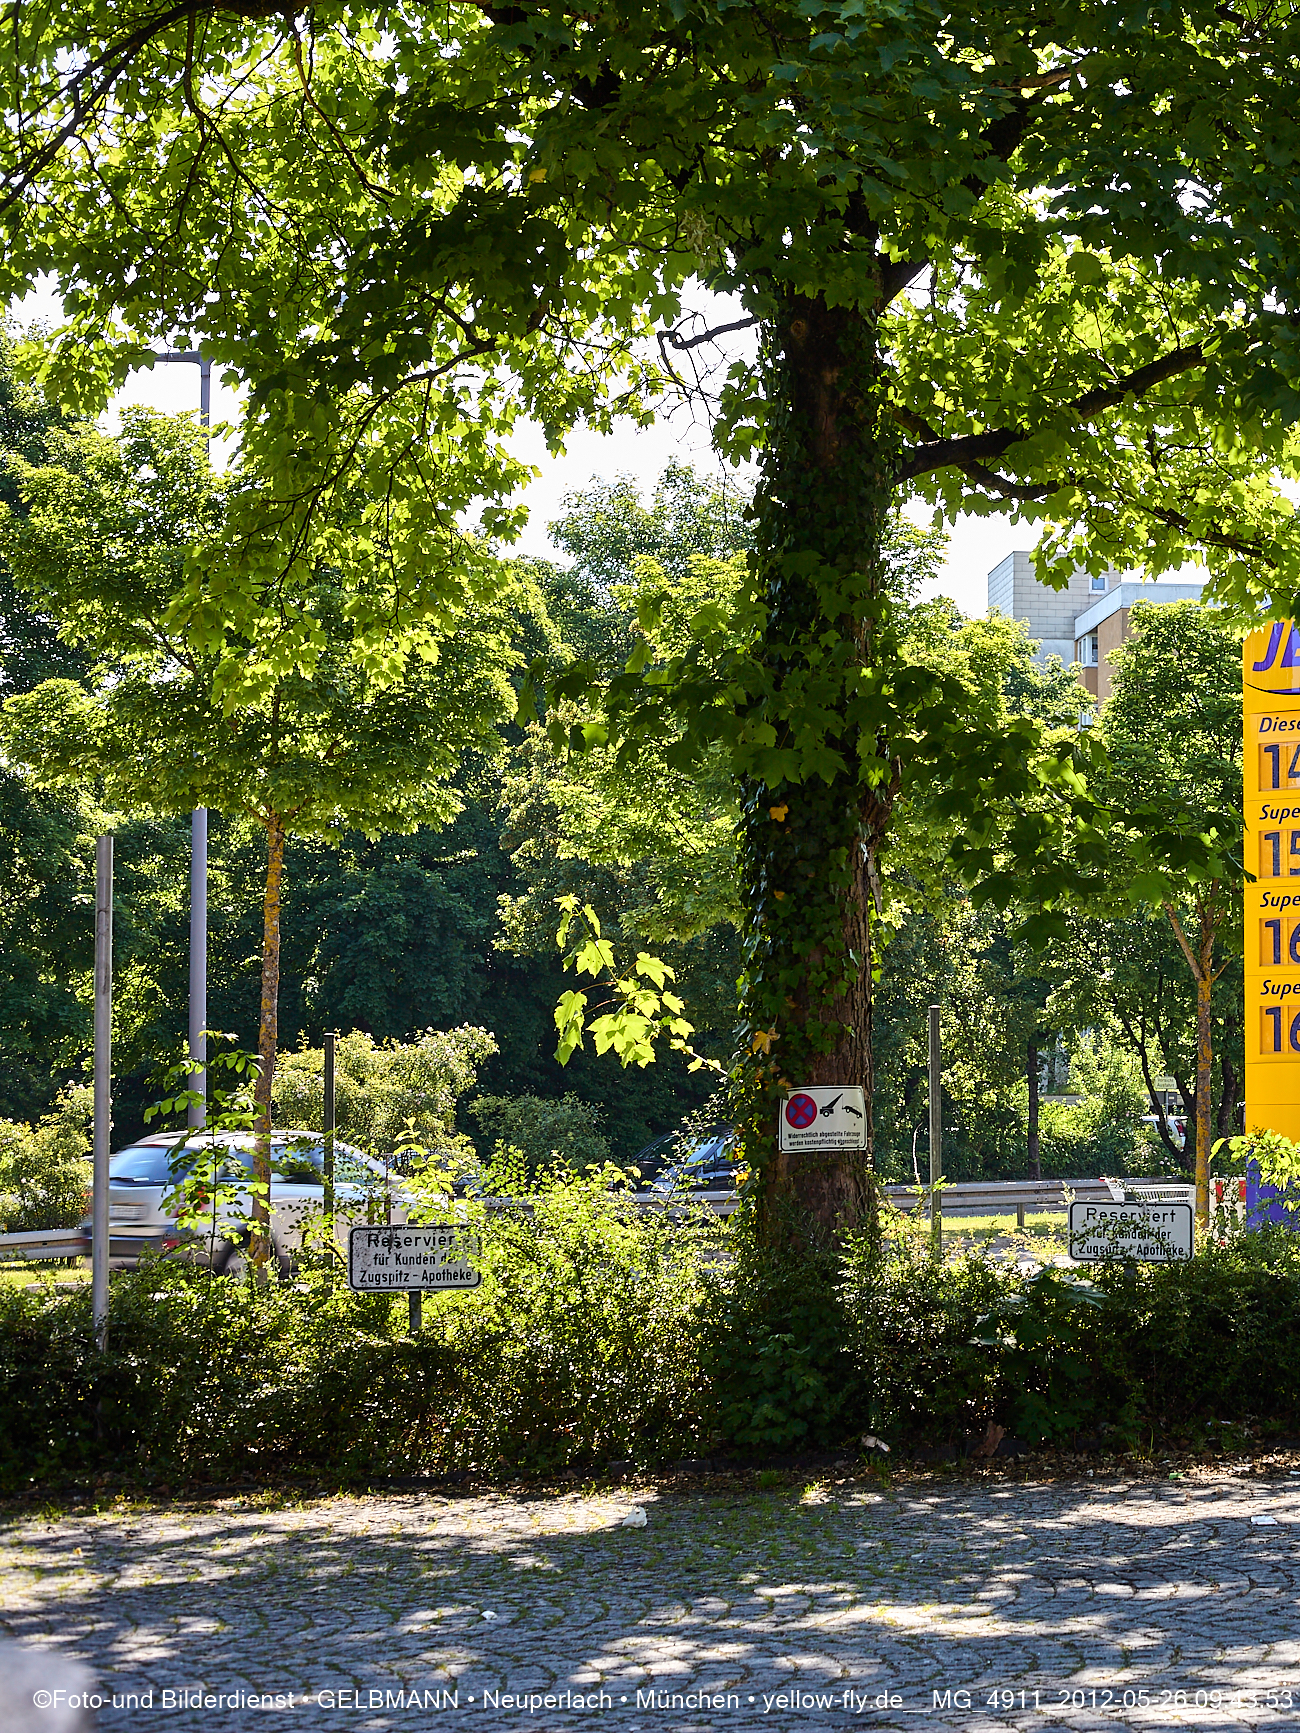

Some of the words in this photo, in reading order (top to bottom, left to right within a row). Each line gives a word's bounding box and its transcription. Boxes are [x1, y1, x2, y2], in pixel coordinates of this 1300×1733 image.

[367, 1232, 462, 1248] Reservier
[373, 1253, 390, 1266] für
[394, 1251, 436, 1266] Kunden
[359, 1269, 410, 1286] Zugspitz
[421, 1268, 472, 1285] Apotheke
